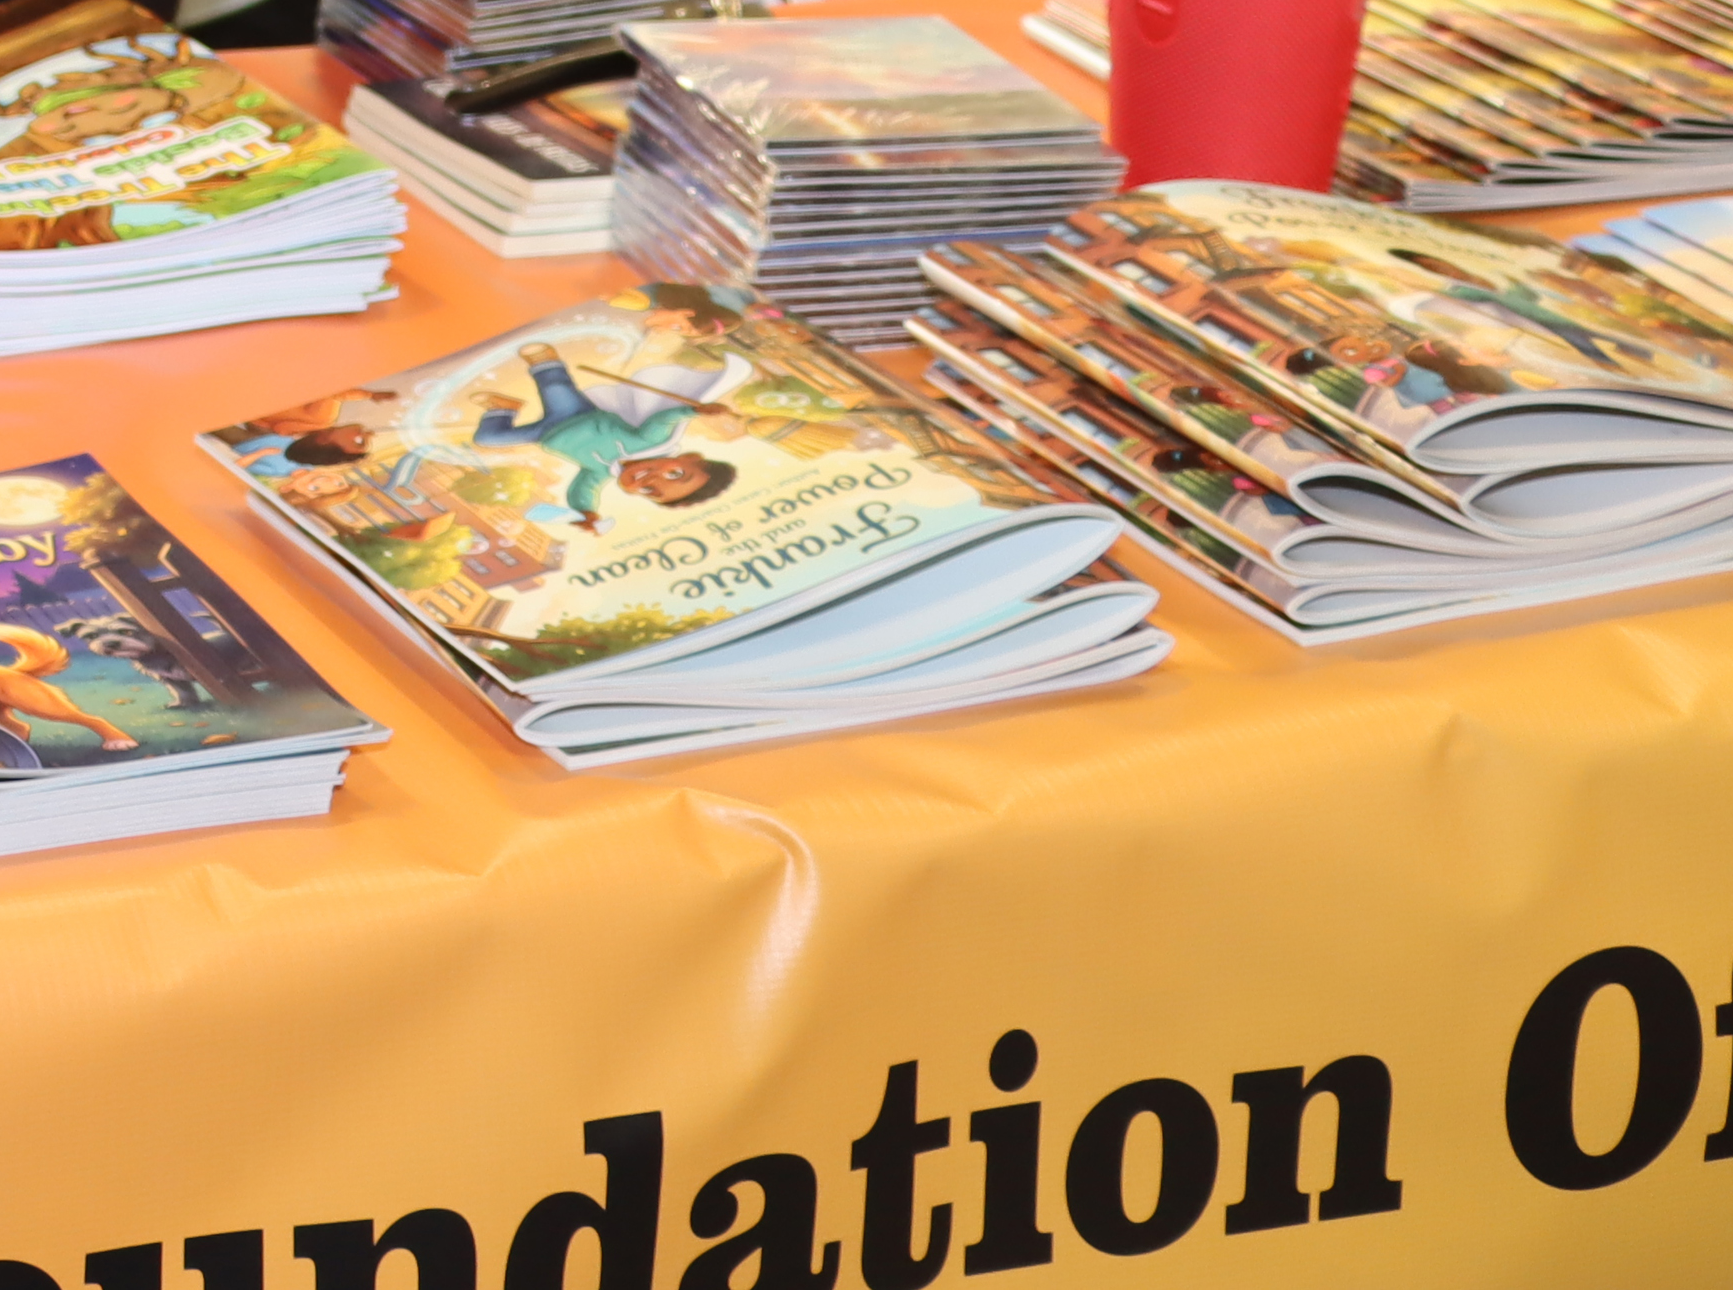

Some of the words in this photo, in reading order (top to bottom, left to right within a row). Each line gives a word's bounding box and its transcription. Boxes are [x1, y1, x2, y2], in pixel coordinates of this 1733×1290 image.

[174, 140, 289, 180] The
[758, 462, 912, 523] Power
[669, 500, 921, 600] Frankie
[705, 518, 744, 543] of
[720, 535, 761, 557] the
[761, 517, 807, 545] and
[568, 534, 710, 589] Clean
